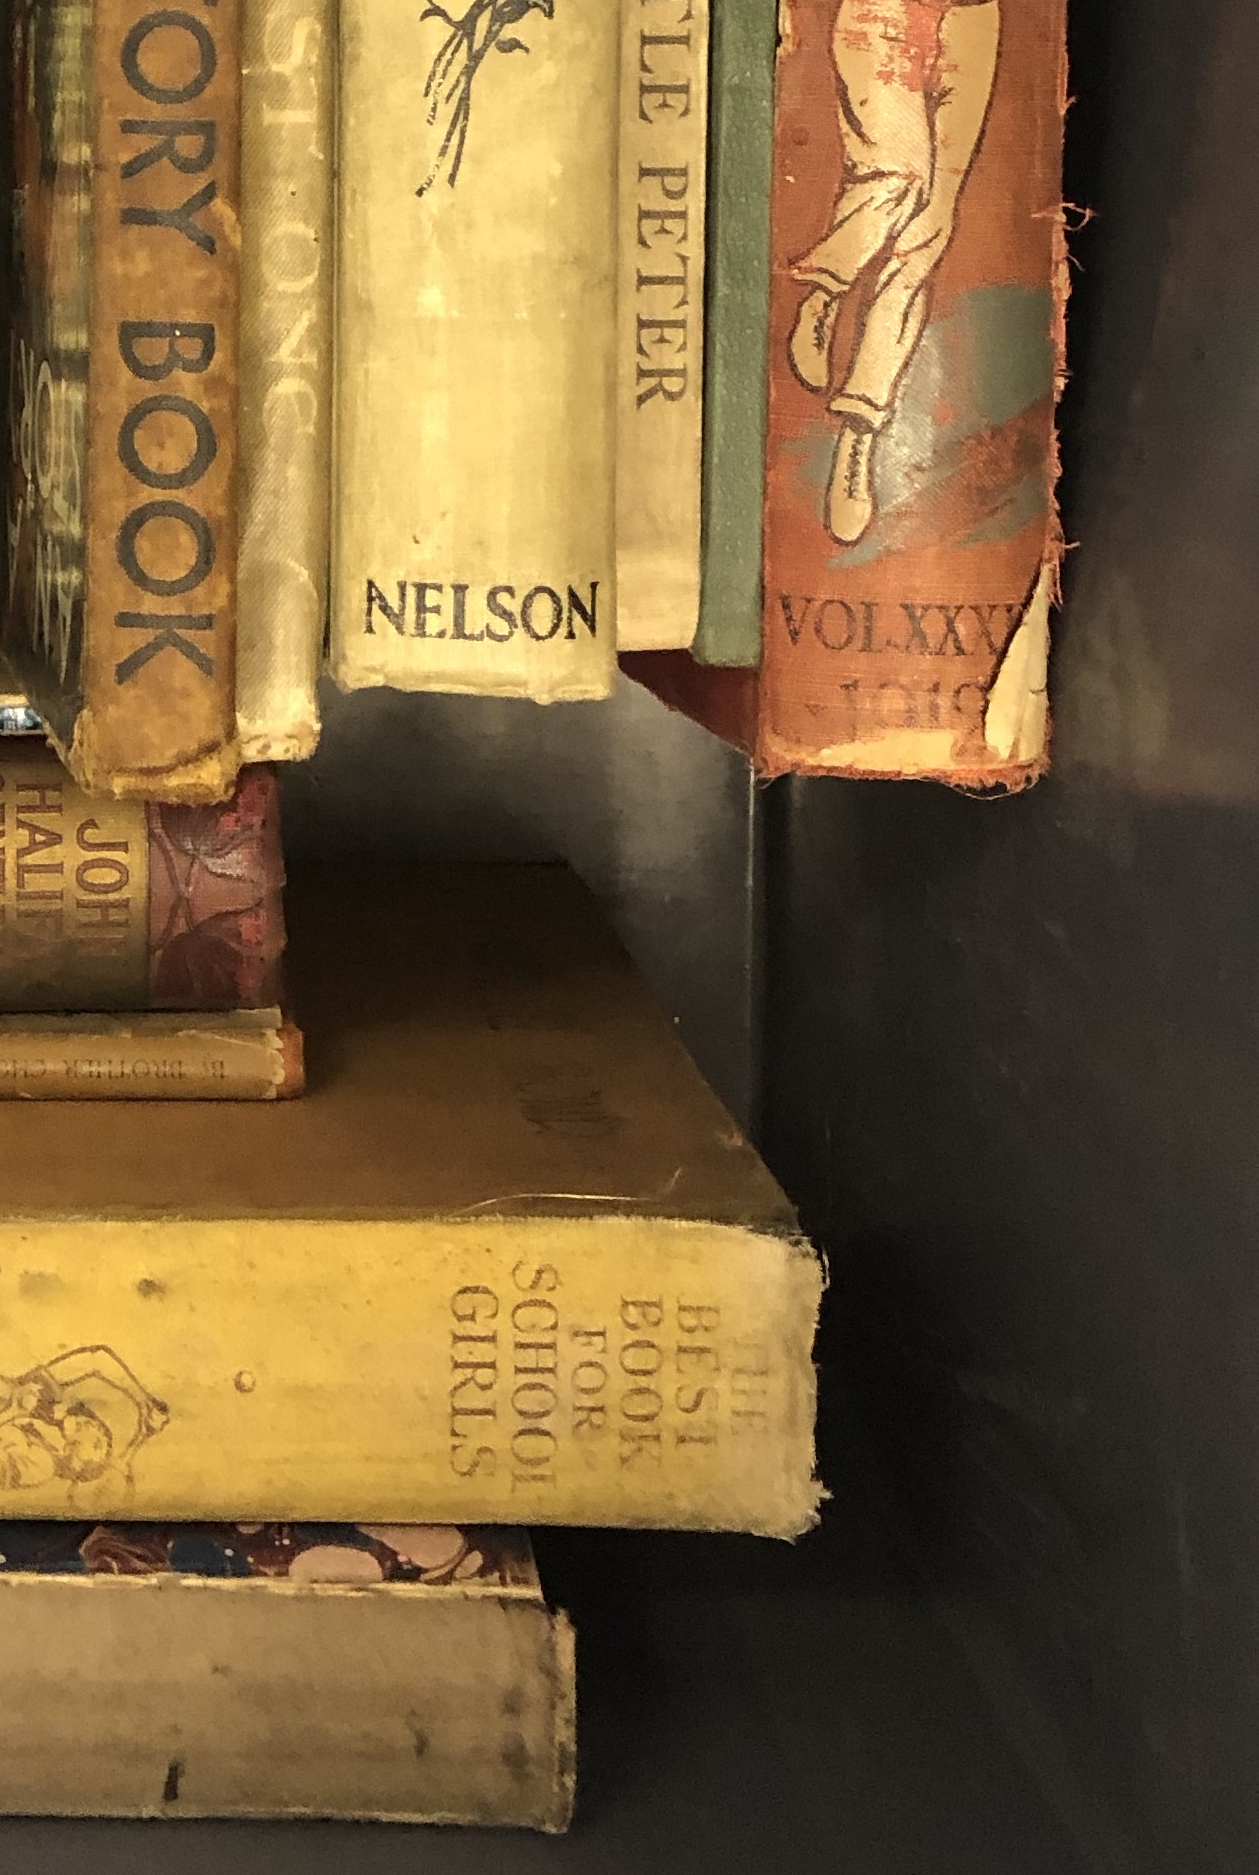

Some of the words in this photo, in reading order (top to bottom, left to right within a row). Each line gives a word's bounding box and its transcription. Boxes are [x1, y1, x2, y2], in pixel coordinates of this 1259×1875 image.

[633, 161, 692, 411] PETER
[114, 317, 215, 687] BOOK
[363, 579, 600, 642] NELSON
[449, 1284, 500, 1480] GIRLS
[510, 1260, 561, 1495] SCHOOL
[570, 1325, 608, 1441] FOR
[618, 1294, 665, 1472] BOOK
[676, 1296, 722, 1451] BEST
[730, 1334, 771, 1438] THE
